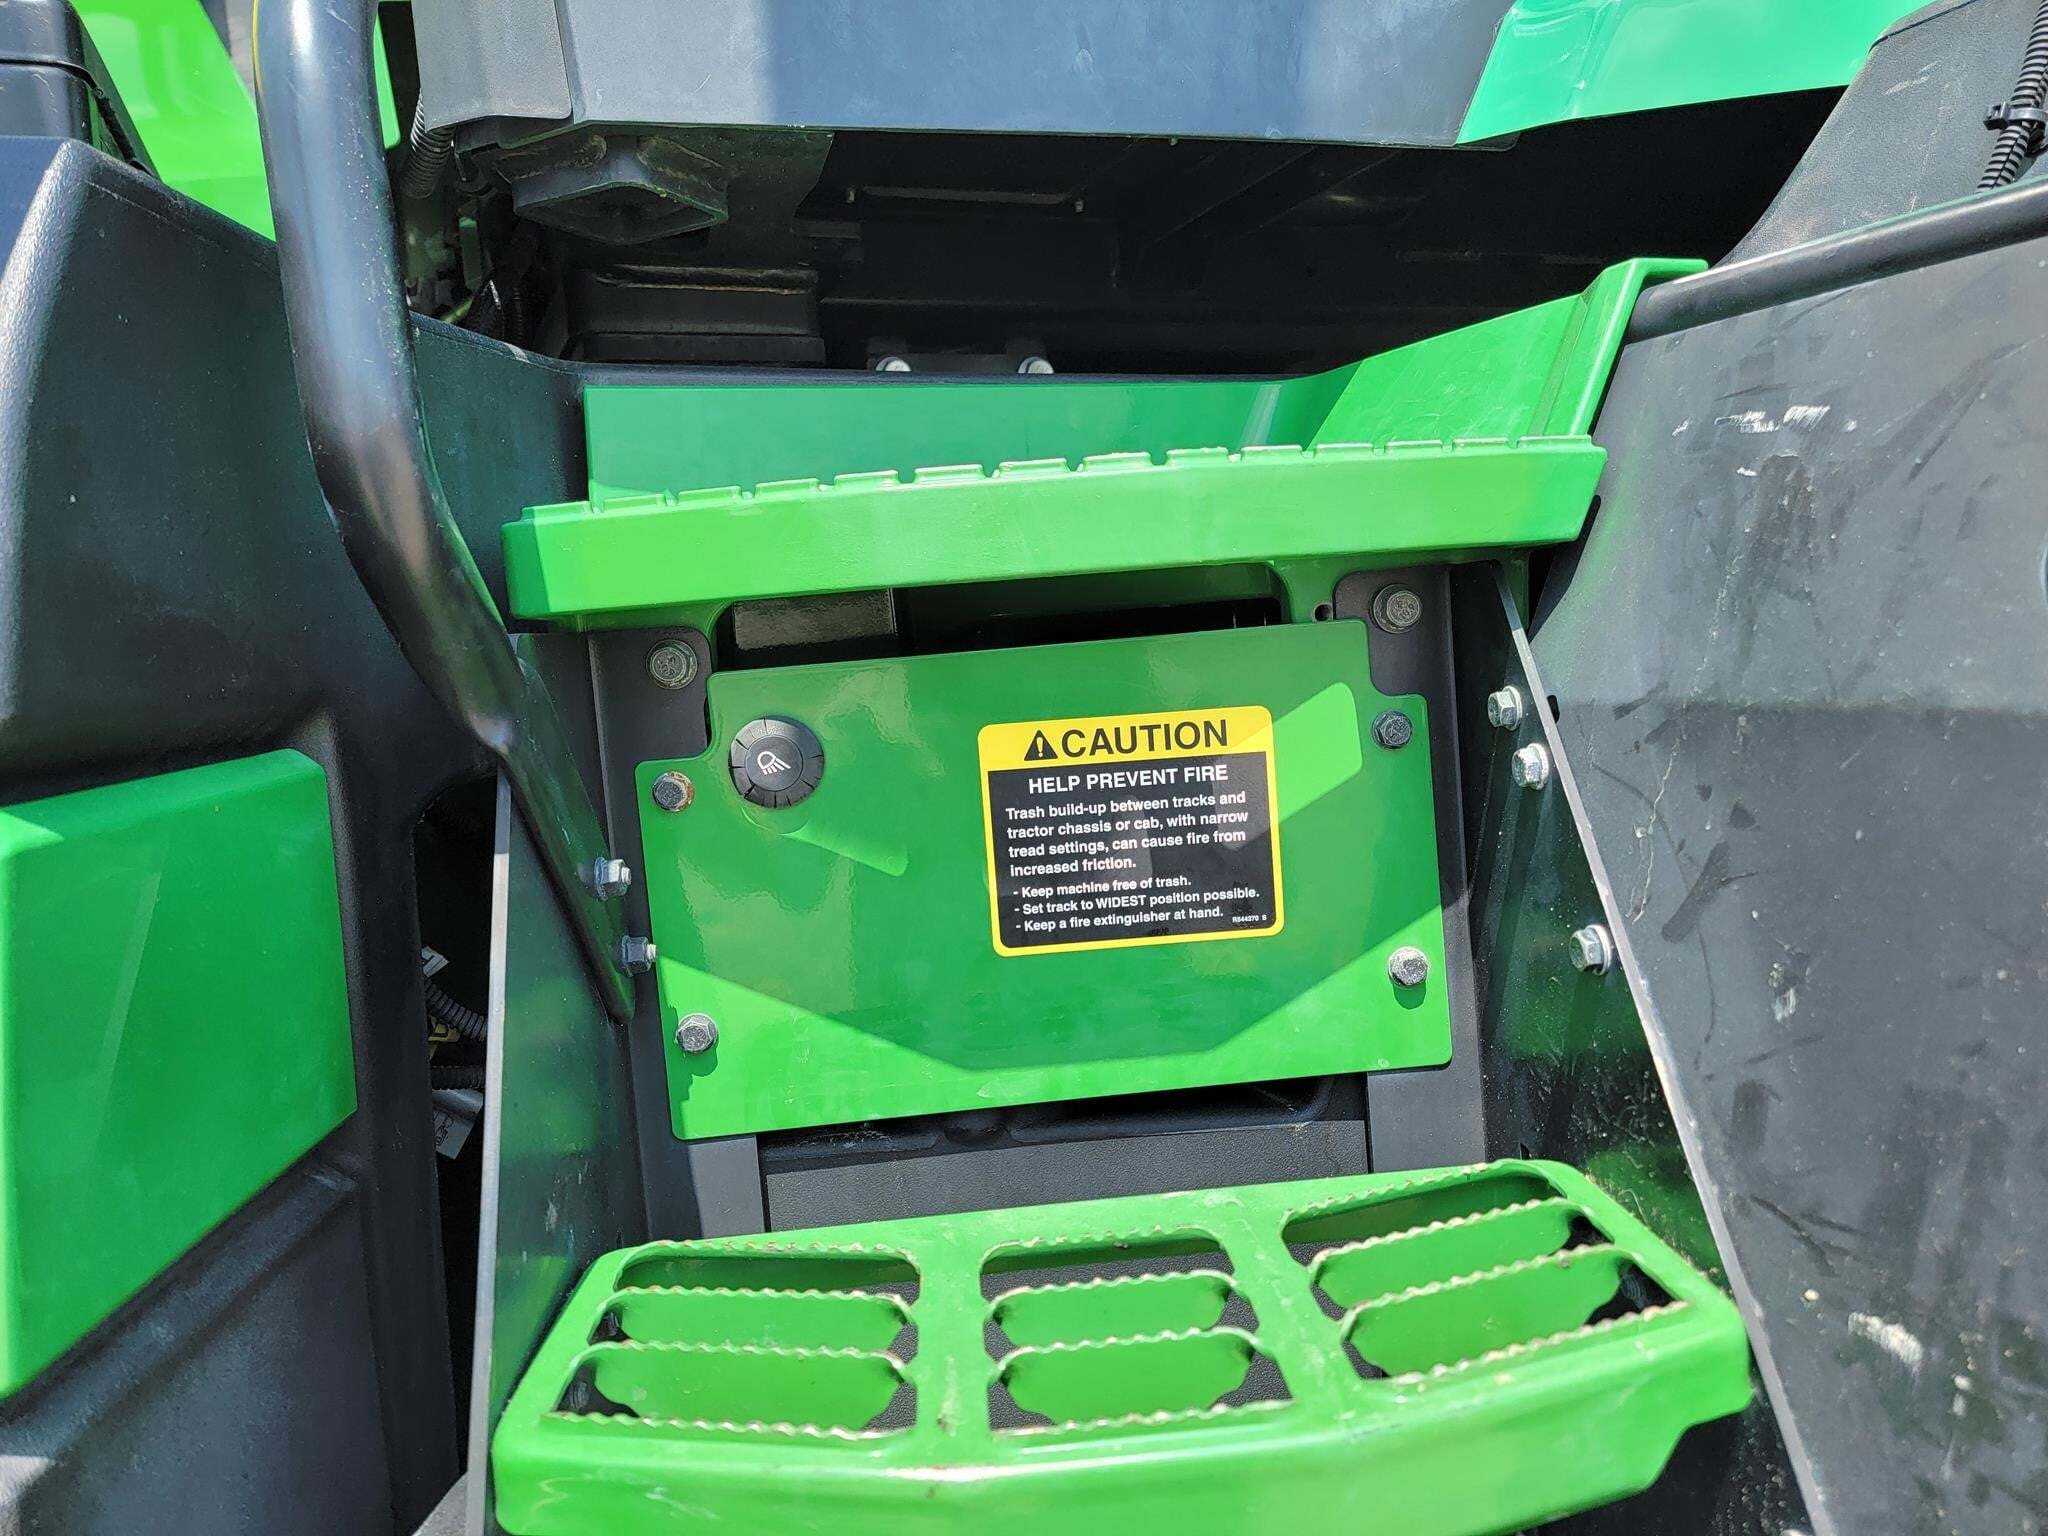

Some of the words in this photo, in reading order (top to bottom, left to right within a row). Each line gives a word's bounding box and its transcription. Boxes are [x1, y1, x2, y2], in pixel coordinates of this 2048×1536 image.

[1062, 719, 1228, 758] CAUTION
[1029, 776, 1080, 794] HELP
[1087, 768, 1178, 789] PREVENT
[1184, 765, 1228, 782] FIRE
[1006, 806, 1045, 820] Trash
[1049, 803, 1106, 817] build-up
[1110, 799, 1168, 812] between
[1173, 794, 1216, 808] tracks
[1219, 791, 1246, 804] and
[1007, 826, 1054, 838] tractor
[1058, 821, 1111, 834] chassis
[1116, 820, 1130, 831] or
[1134, 816, 1163, 831] cab,
[1167, 814, 1195, 827] with
[1200, 811, 1248, 824] narrow
[1008, 844, 1044, 857] tread
[1049, 841, 1109, 855] settings,
[1112, 839, 1137, 850] can
[1141, 834, 1183, 847] cause
[1186, 832, 1209, 844] fire
[1213, 830, 1245, 842] from
[1011, 860, 1078, 876] increased
[1082, 857, 1136, 870] friction.
[1022, 887, 1053, 898] Keep
[1057, 882, 1110, 894] machine
[1112, 880, 1137, 891] free
[1140, 877, 1152, 888] of
[1155, 875, 1191, 887] trash.
[1023, 903, 1043, 914] Set
[1046, 900, 1078, 912] track
[1081, 900, 1093, 910] to
[1096, 895, 1147, 908] WIDEST
[1150, 893, 1200, 906] position
[1204, 887, 1259, 903] possible.
[1025, 920, 1056, 932] Keep
[1059, 920, 1067, 928] a
[1070, 917, 1090, 927] fire
[1094, 912, 1171, 925] extinguisher
[1174, 910, 1186, 920] at
[1189, 906, 1223, 918] hand.
